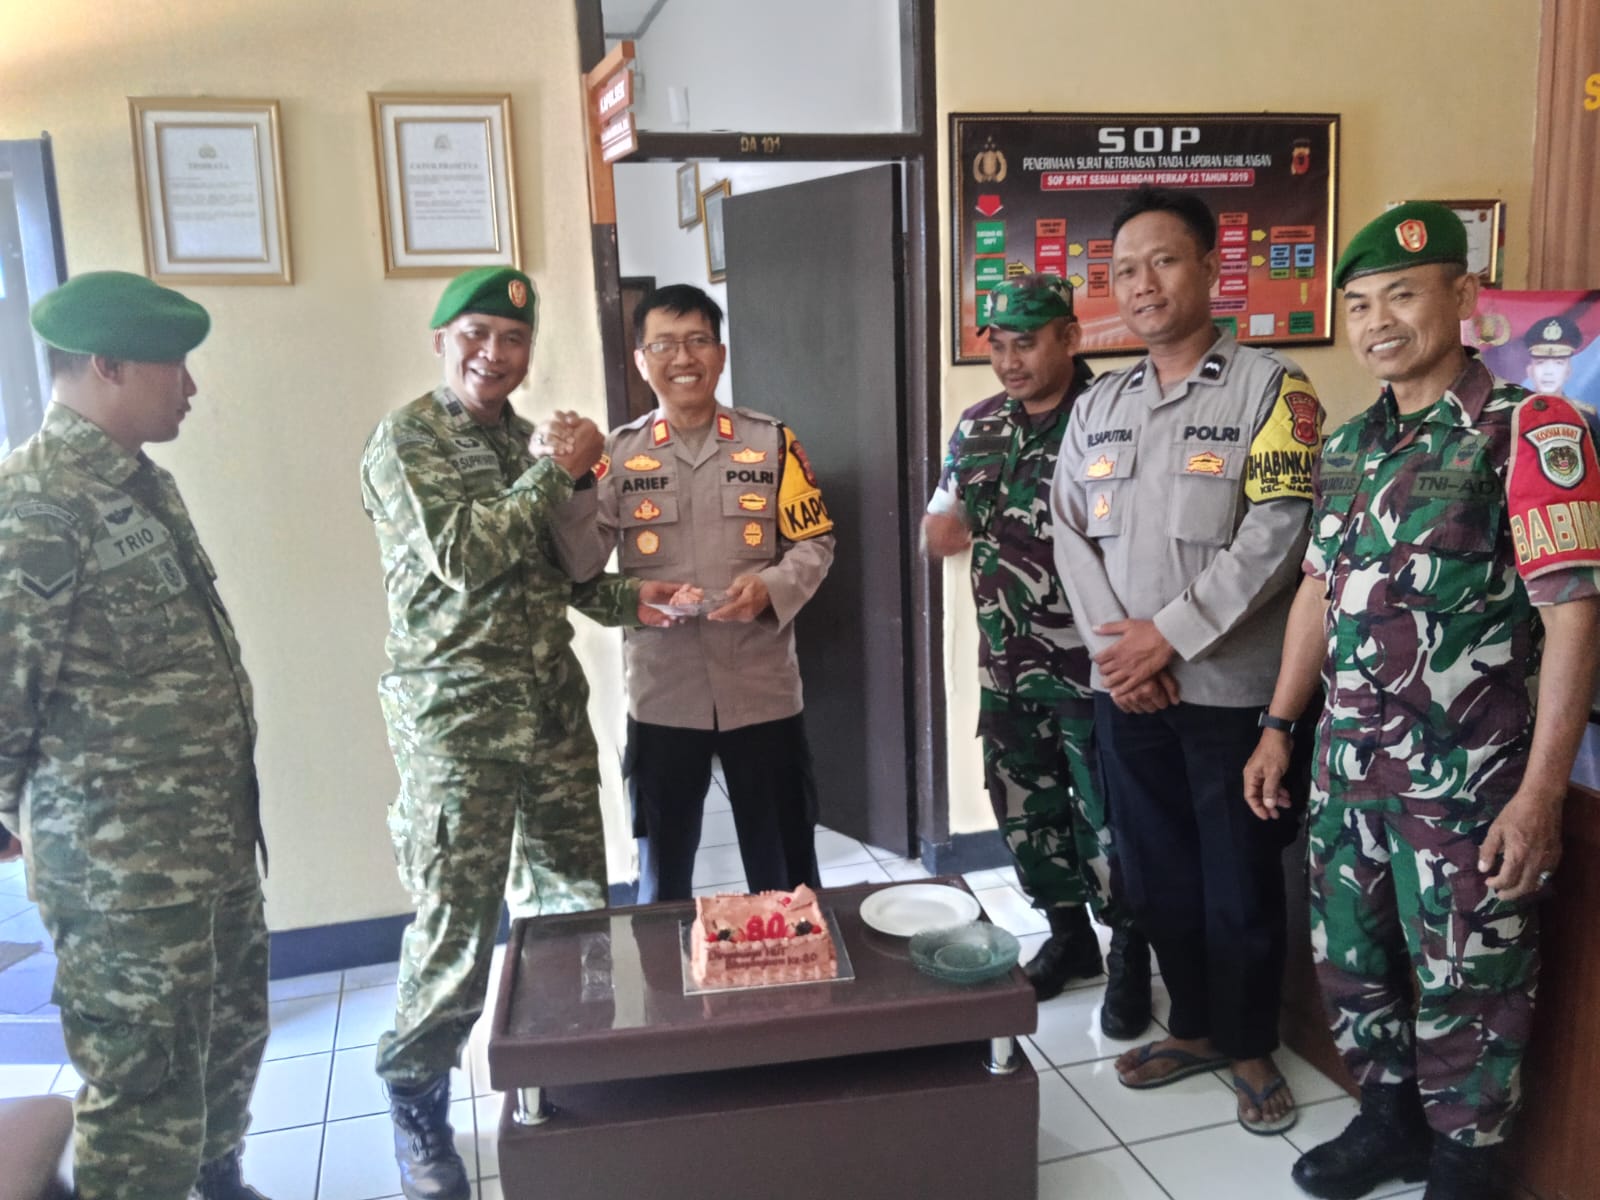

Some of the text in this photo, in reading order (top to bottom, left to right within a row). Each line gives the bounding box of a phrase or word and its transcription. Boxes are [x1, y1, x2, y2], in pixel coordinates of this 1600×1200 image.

[740, 136, 757, 154] DA
[1098, 127, 1201, 153] SOP
[1023, 153, 1272, 171] PENERIMAAN SURAT KETERANGAN TANDA LAPORAN KEHILANGAN
[1047, 171, 1249, 186] SOP SPKT SESUAI DENGAN PERKAP 12 TAHUN 2019
[1184, 426, 1240, 442] POLRI
[1248, 451, 1313, 480] BHABINKA
[622, 476, 669, 493] ARIEF
[726, 470, 774, 485] POLRI
[113, 528, 154, 557] TRIO
[747, 911, 787, 941] 80
